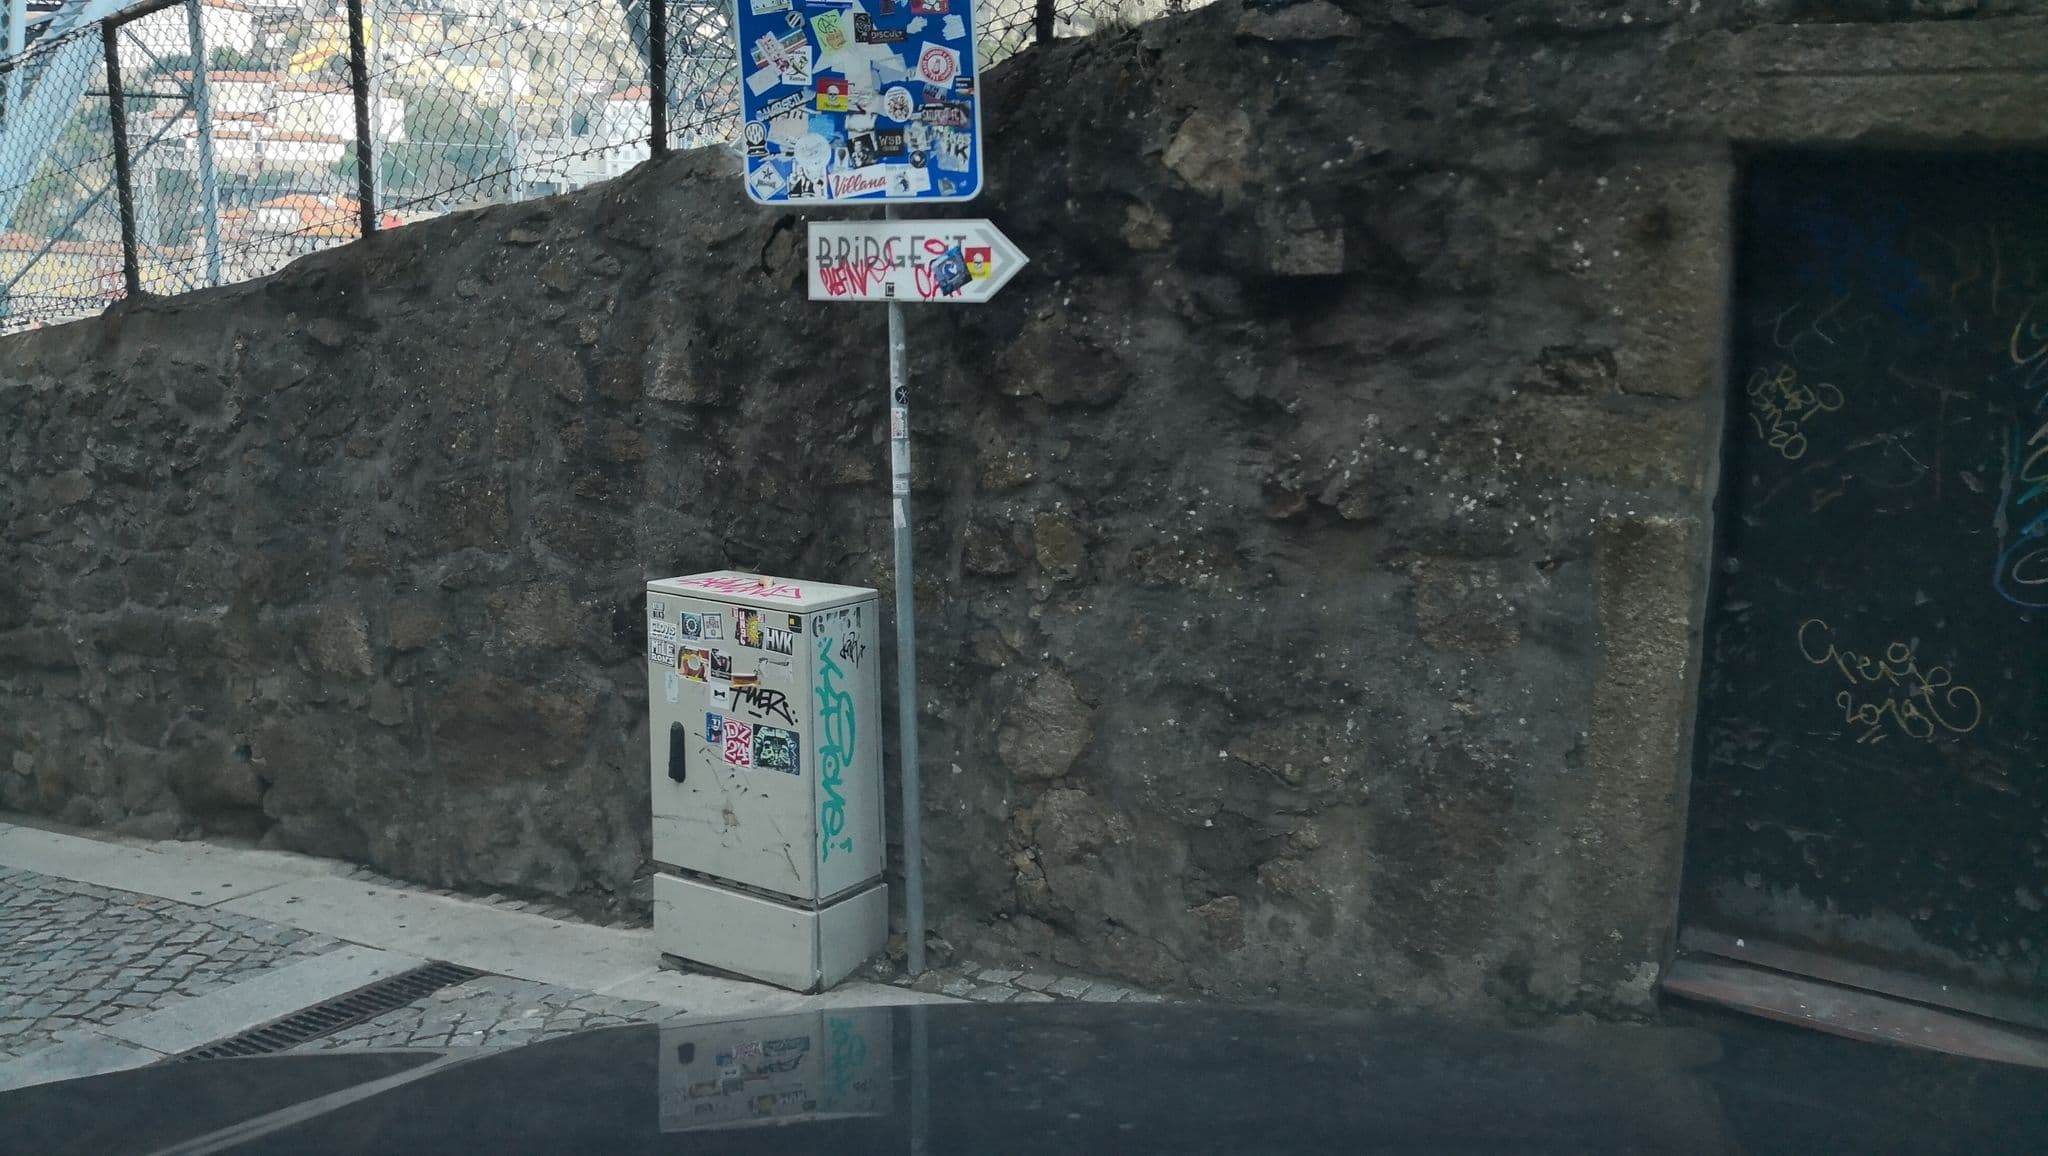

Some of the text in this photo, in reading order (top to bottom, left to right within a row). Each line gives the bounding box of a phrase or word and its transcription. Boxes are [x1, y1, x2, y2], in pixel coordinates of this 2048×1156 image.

[834, 174, 886, 197] Villana
[766, 628, 793, 655] HVK
[723, 720, 752, 745] DZ
[724, 740, 751, 765] 24
